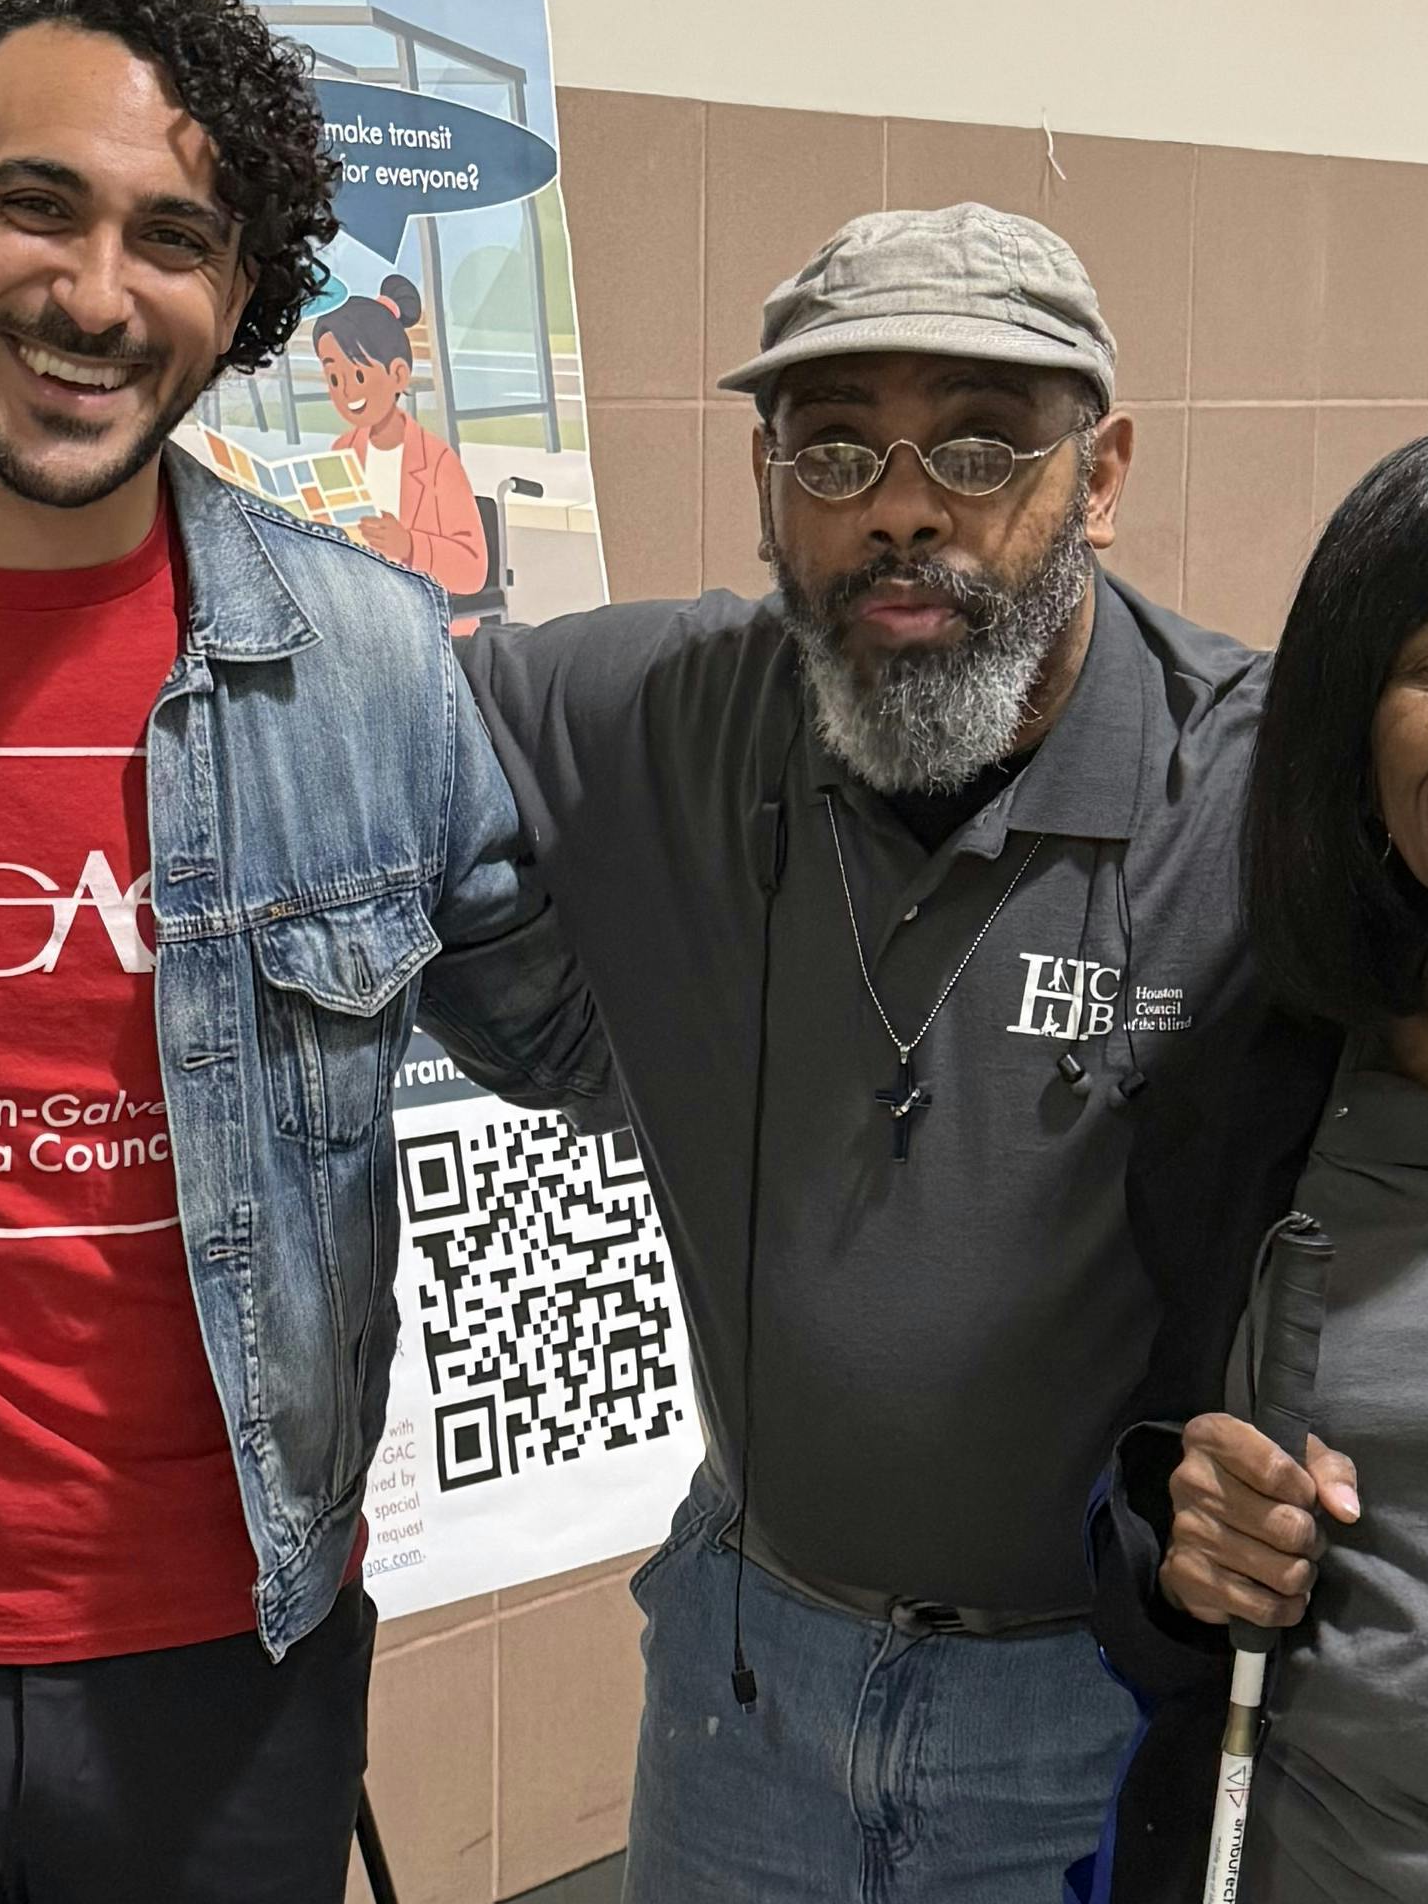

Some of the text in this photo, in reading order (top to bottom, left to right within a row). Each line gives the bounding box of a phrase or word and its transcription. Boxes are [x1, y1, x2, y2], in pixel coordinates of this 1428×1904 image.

[324, 115, 452, 150] make transit
[340, 153, 480, 194] for everyone?
[1135, 985, 1184, 1000] Houston
[1135, 1001, 1182, 1016] Council
[1123, 1015, 1192, 1032] of the blind
[28, 1131, 173, 1173] Counc
[388, 1418, 415, 1438] with
[375, 1441, 417, 1467] -GAC
[400, 1470, 417, 1491] by
[374, 1491, 421, 1521] special
[376, 1519, 424, 1549] request
